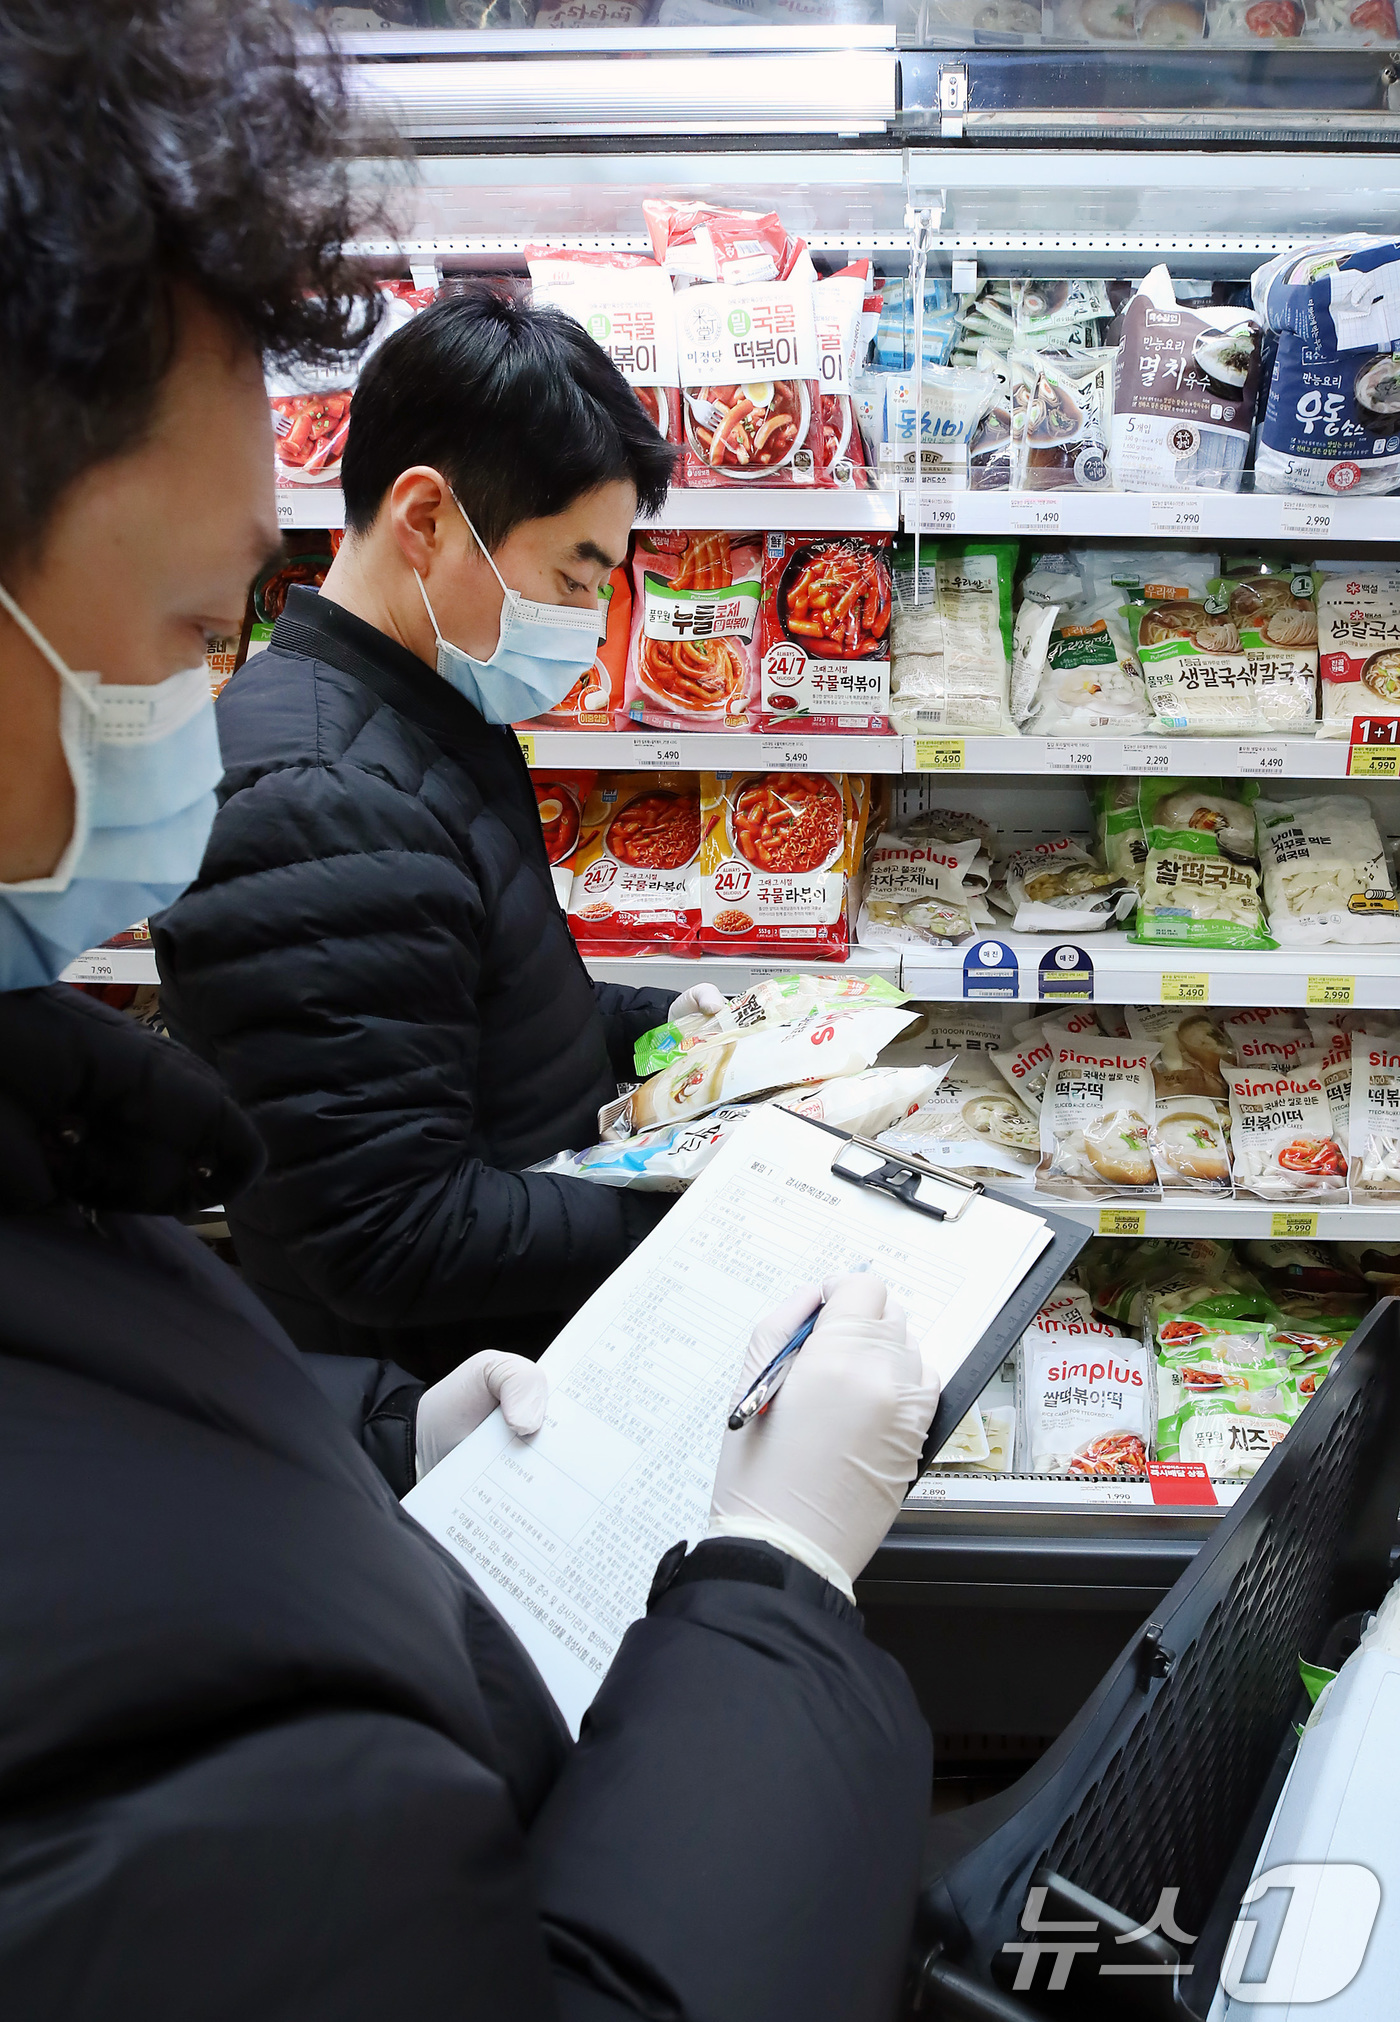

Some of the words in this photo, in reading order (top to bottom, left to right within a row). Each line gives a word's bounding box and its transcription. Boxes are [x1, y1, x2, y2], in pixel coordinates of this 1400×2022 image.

[752, 304, 796, 335] 국물
[613, 313, 655, 341] 국물
[1143, 336, 1186, 354] 만능요리
[687, 350, 722, 364] 미정당
[733, 336, 798, 370] 떡볶이
[603, 344, 658, 380] 볶이
[1302, 372, 1343, 389] 만능요리
[932, 511, 956, 522] 1,990
[1036, 511, 1060, 522] 1,490
[1176, 513, 1200, 524] 2,990
[1306, 515, 1331, 526] 2,990
[951, 576, 984, 595] 우리쌀
[1145, 585, 1177, 600] 우리쌀
[1361, 584, 1378, 595] 백설
[649, 608, 670, 624] 풀무원
[672, 604, 716, 636] 누들
[726, 616, 750, 630] 떡볶이
[767, 657, 807, 677] 24/7
[812, 664, 826, 674] 그때
[834, 664, 848, 674] 시절
[1147, 674, 1174, 688] 풀무원
[1359, 720, 1400, 744] 1+1
[657, 751, 680, 761] 5,490
[785, 753, 808, 762] 5,490
[933, 754, 961, 764] 6,490
[1070, 754, 1092, 763] 1,290
[1146, 756, 1169, 766] 2,290
[1260, 758, 1283, 768] 4,490
[1369, 761, 1396, 771] 4,990
[1271, 828, 1304, 844] 나이를
[1274, 838, 1307, 854] 거꾸로
[1308, 836, 1332, 845] 먹는
[873, 847, 958, 870] simplus
[1276, 848, 1310, 864] 떡국떡
[584, 867, 619, 887] 24/7
[714, 872, 752, 891] 24/7
[757, 878, 771, 887] 그때
[779, 878, 793, 887] 시절
[91, 966, 112, 976] 7,990
[1178, 987, 1204, 997] 3,490
[1323, 990, 1350, 1000] 2,990
[1059, 1048, 1148, 1070] simplus
[1082, 1070, 1106, 1082] 국내산
[1107, 1072, 1124, 1082] 쌀로
[1234, 1078, 1322, 1098] simplus
[1263, 1099, 1286, 1112] 국내산
[1286, 1097, 1302, 1107] 쌀로
[1302, 1096, 1319, 1107] 만든
[750, 1160, 766, 1173] 붙임
[1115, 1222, 1139, 1231] 2,690
[1287, 1224, 1311, 1234] 2,990
[1047, 1359, 1144, 1387] simplus
[1043, 1387, 1124, 1410] 쌀떡볶이떡
[1228, 1425, 1270, 1453] 치즈
[1150, 1469, 1186, 1478] 즉시배달
[1187, 1470, 1206, 1478] 상품
[921, 1488, 946, 1497] 2,890
[1107, 1493, 1131, 1501] 1,990
